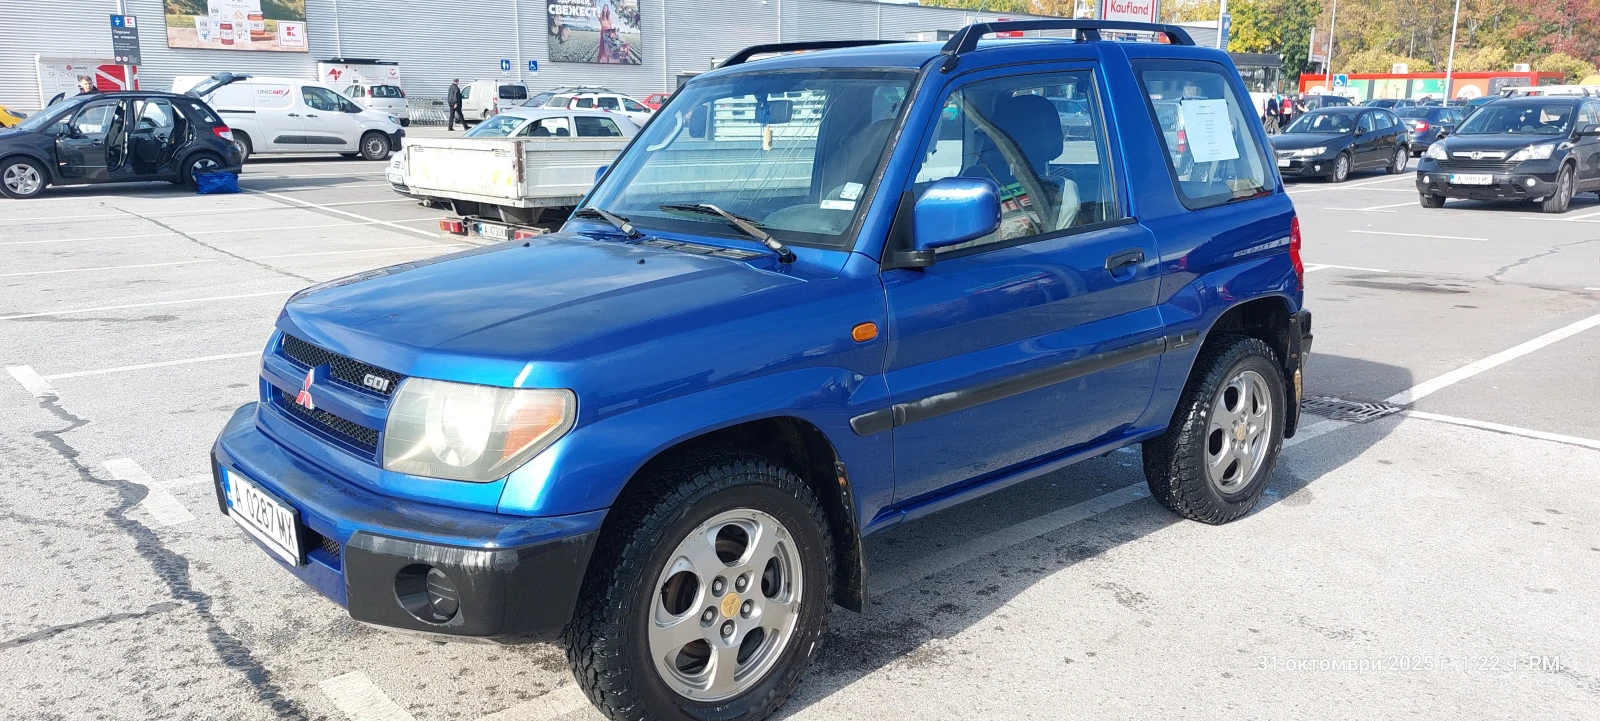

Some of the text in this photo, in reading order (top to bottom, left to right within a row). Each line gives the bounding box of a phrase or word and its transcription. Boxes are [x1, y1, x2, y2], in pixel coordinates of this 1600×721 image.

[548, 4, 601, 17] СВЕЖЕСТ!
[1110, 0, 1149, 15] Kaufland
[363, 373, 390, 391] GDI
[234, 479, 244, 512] A
